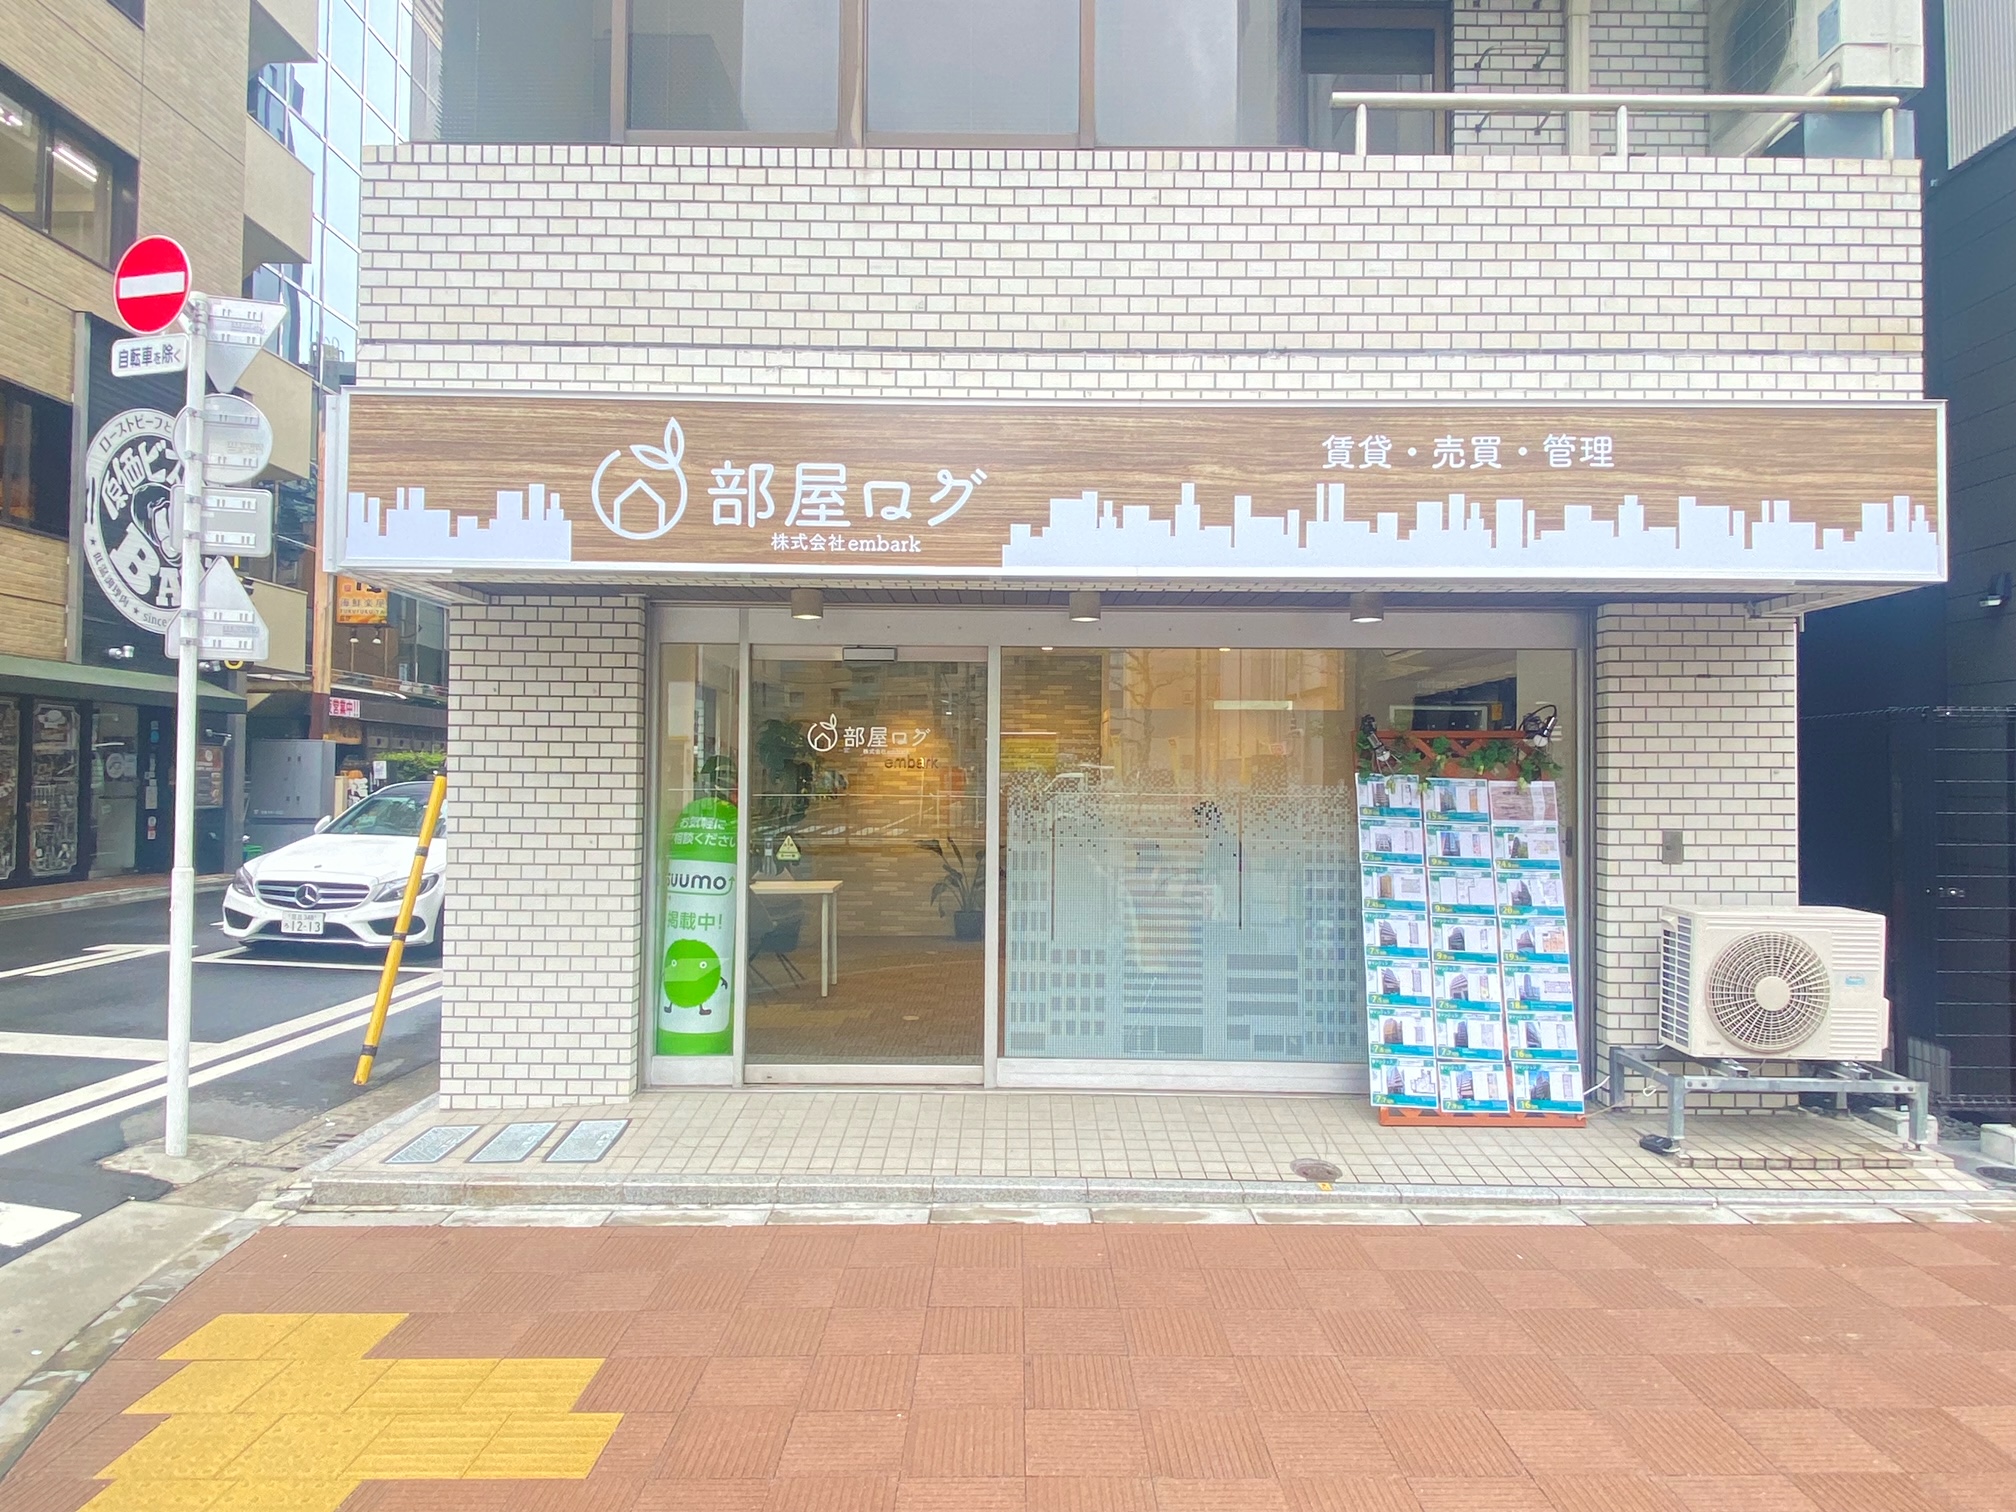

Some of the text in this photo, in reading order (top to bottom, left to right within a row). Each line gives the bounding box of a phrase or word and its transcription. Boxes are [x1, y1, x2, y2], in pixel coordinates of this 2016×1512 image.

[118, 344, 181, 368] 自転車を除く
[99, 414, 172, 453] ローストビーフと
[1321, 433, 1616, 469] 賃貸・売買・管理
[707, 459, 988, 528] 部屋ログ
[770, 532, 922, 553] 株式会社embark
[109, 521, 182, 607] BA
[843, 726, 931, 749] 部屋ログ
[680, 816, 726, 830] お気軽に
